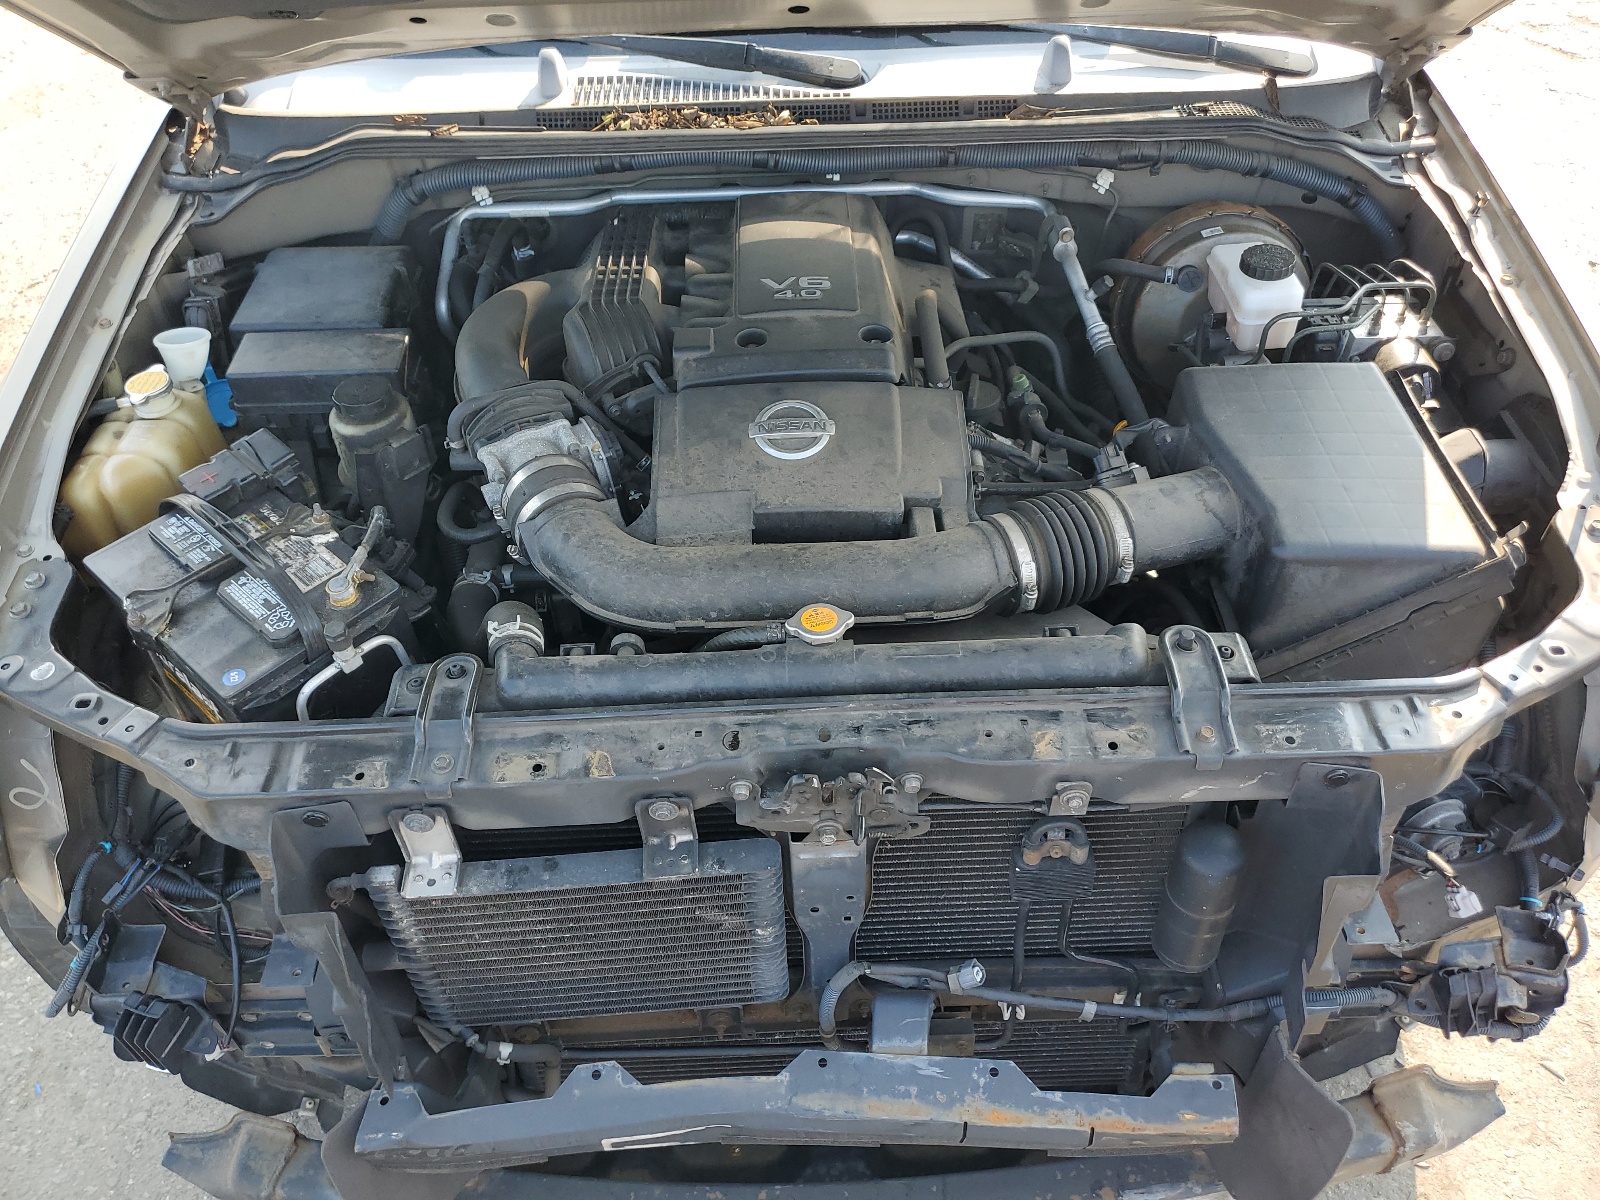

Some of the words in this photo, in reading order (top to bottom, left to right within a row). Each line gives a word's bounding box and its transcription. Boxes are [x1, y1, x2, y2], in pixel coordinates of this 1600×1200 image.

[759, 276, 831, 290] V6
[773, 289, 822, 299] 4.0
[758, 420, 827, 433] NISSAN
